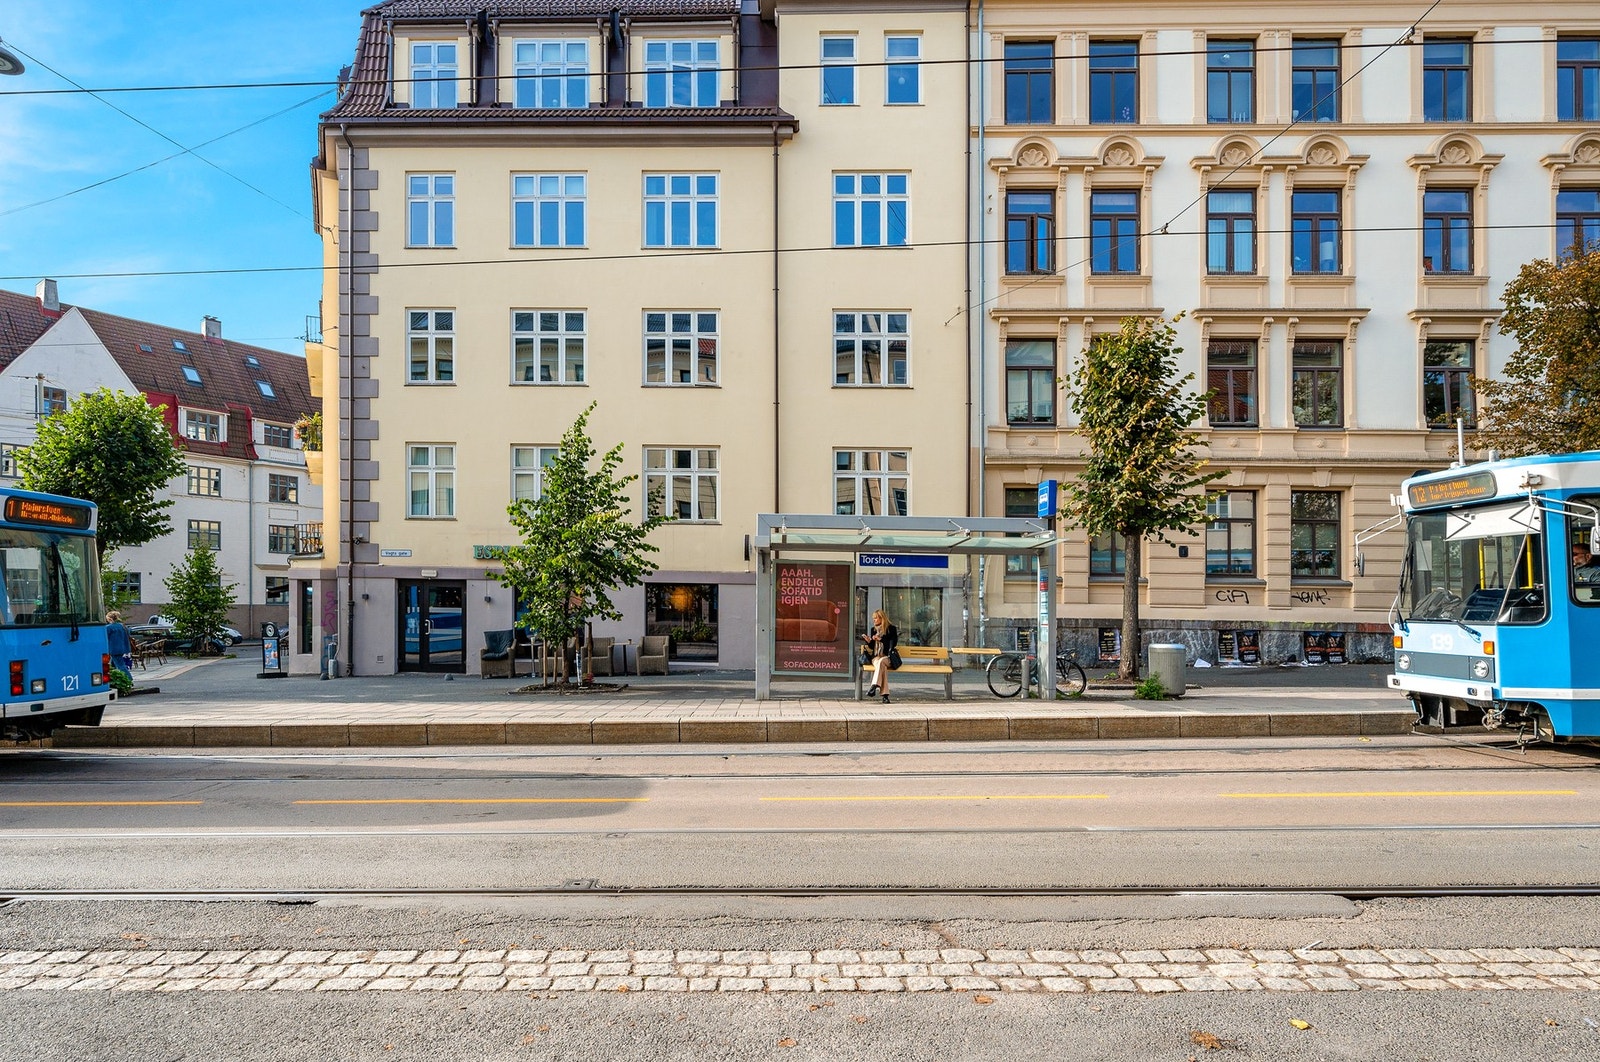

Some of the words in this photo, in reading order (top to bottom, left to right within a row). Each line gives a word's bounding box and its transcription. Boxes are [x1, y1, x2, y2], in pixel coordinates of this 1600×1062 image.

[8, 500, 15, 517] 1
[860, 554, 896, 565] Torshov
[781, 568, 814, 578] AAAH.
[781, 577, 824, 587] ENDELIG
[781, 586, 823, 596] SOFATID
[781, 595, 808, 607] IGJEN
[1430, 632, 1454, 651] 139
[783, 660, 842, 670] SOFACOMPANY
[60, 674, 79, 692] 121
